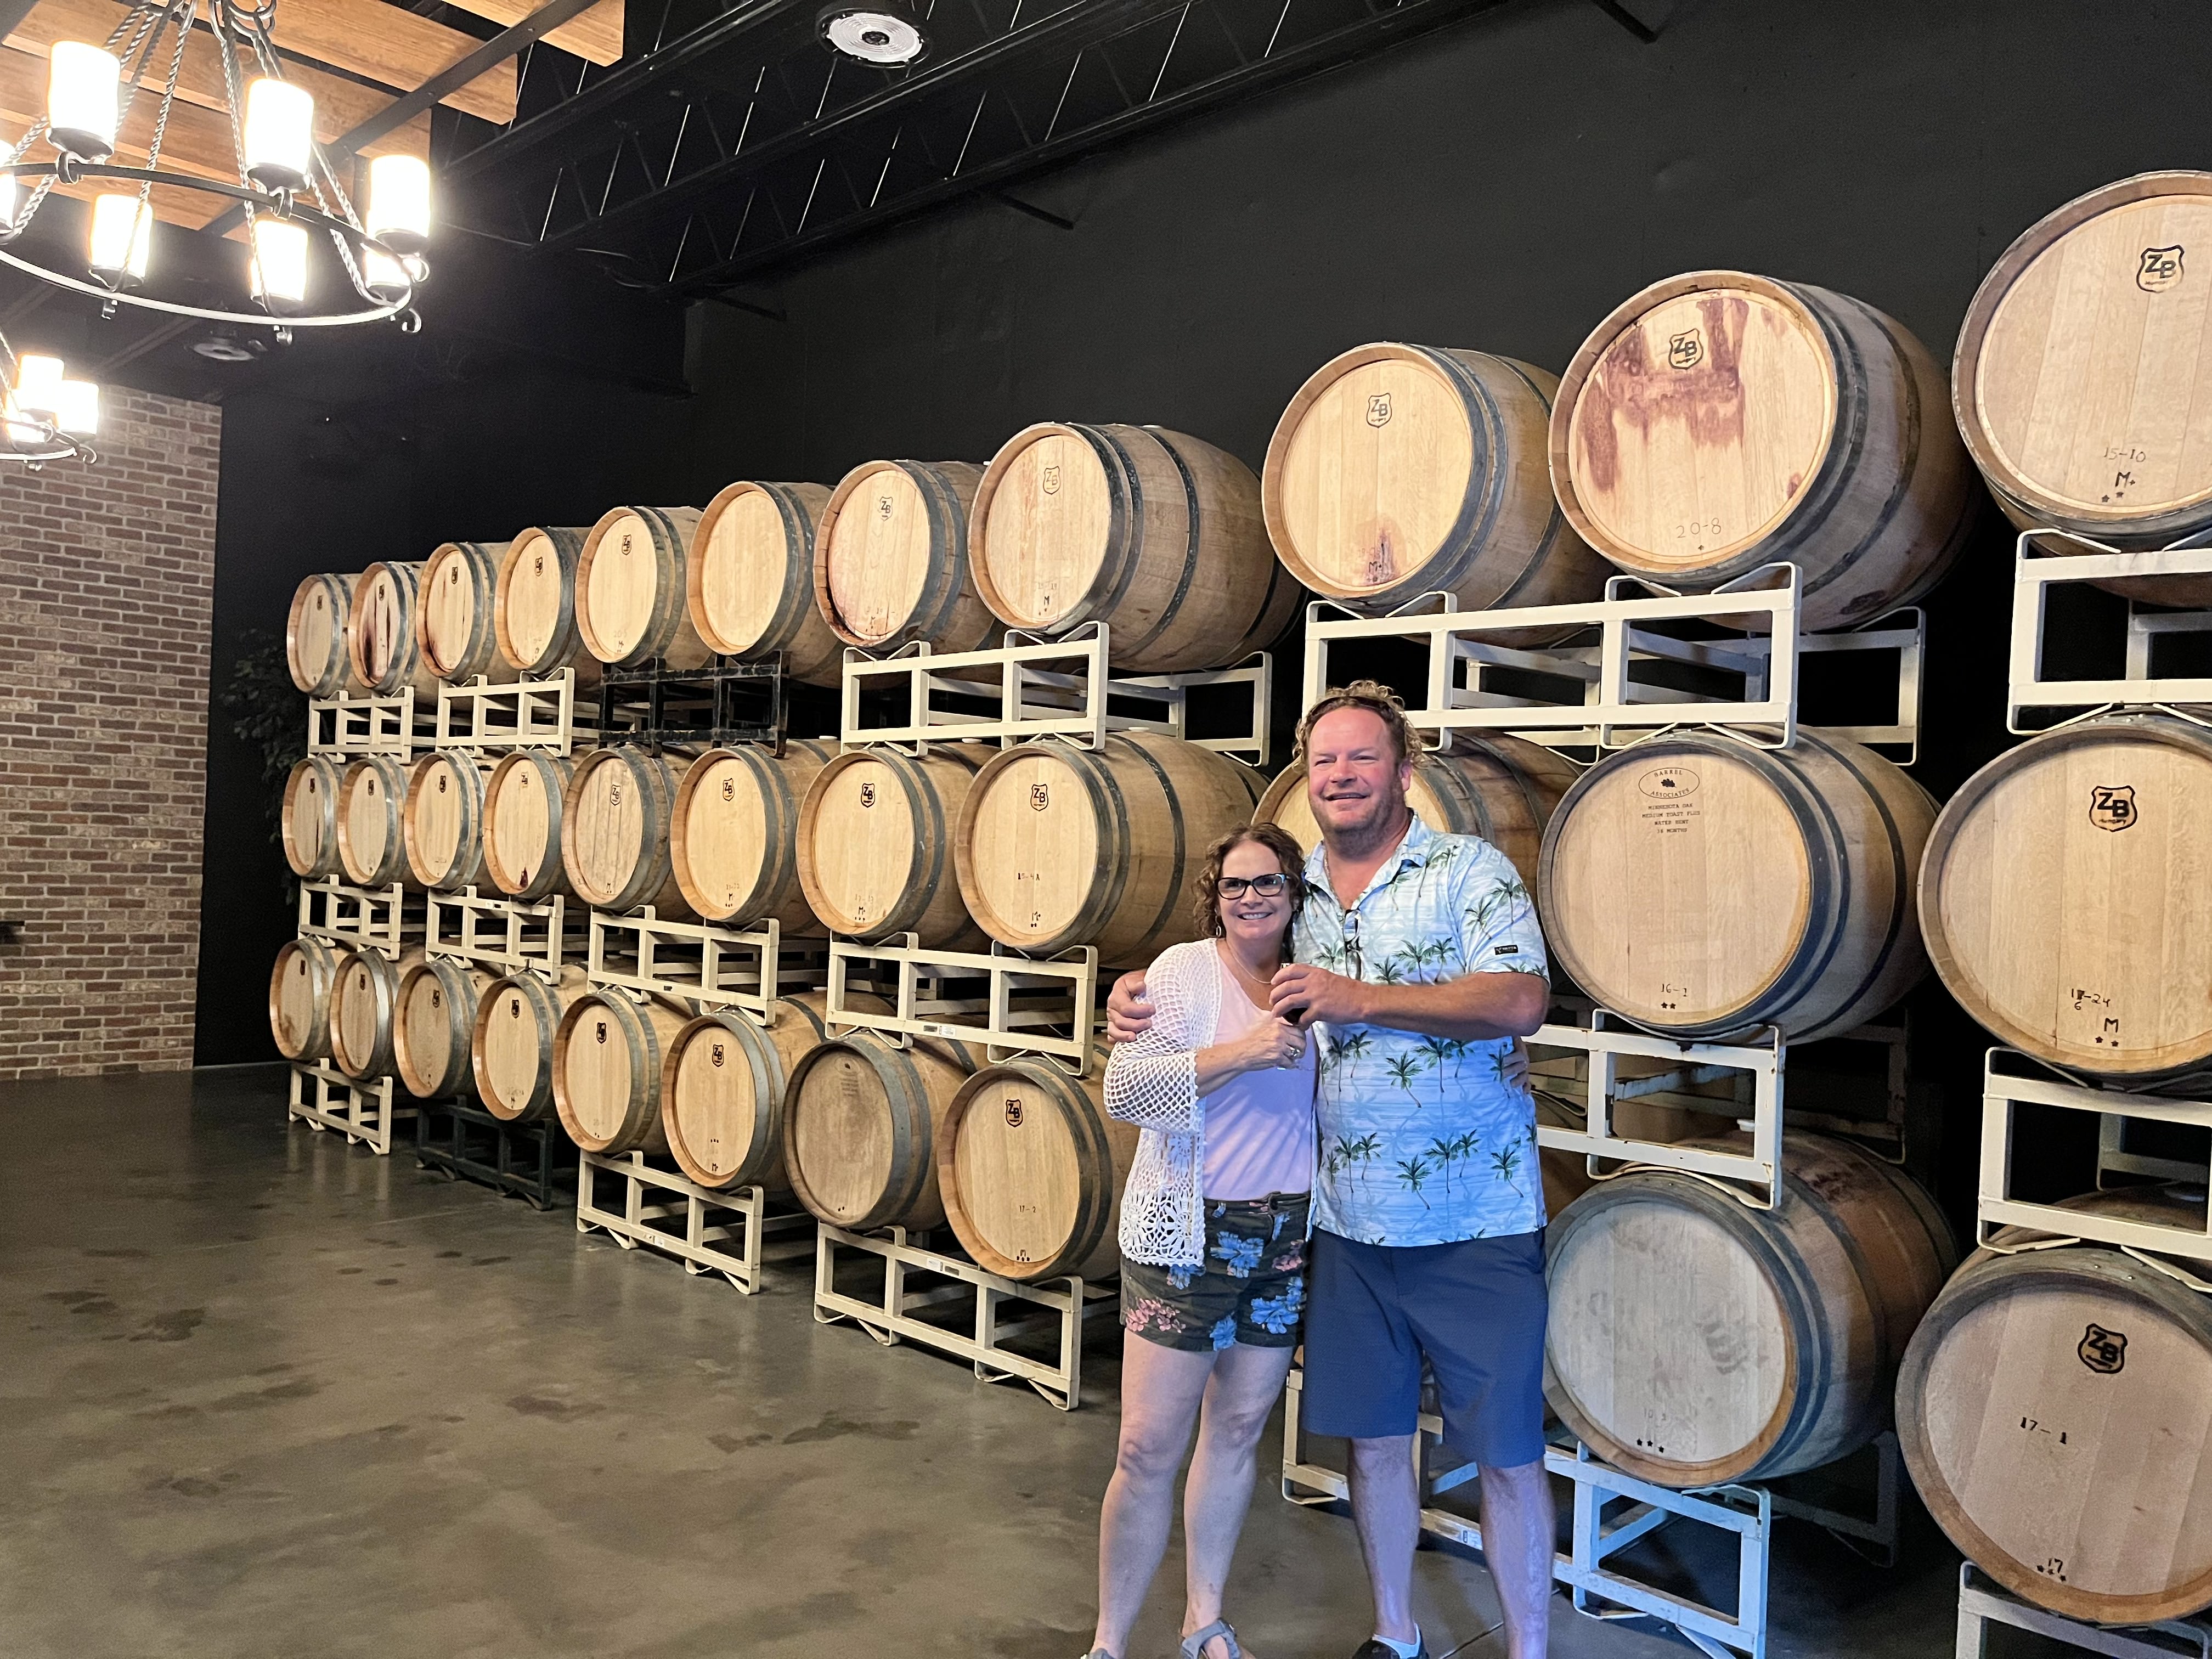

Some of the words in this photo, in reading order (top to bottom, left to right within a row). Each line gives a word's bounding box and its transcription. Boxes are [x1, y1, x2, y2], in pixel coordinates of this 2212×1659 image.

[2145, 253, 2176, 279] ZB
[1674, 337, 1697, 358] ZB
[1370, 399, 1388, 417] ZB
[1046, 471, 1058, 486] ZB
[881, 500, 891, 514] ZB
[1654, 769, 1683, 778] BARREL
[724, 782, 733, 794] ZB
[863, 786, 873, 800] ZB
[1034, 788, 1046, 803] ZB
[1650, 787, 1690, 798] ASSOCIATES
[2097, 792, 2129, 818] ZB
[2104, 1017, 2119, 1033] M
[713, 1047, 723, 1060] ZB
[1007, 1103, 1020, 1119] ZB
[2087, 1330, 2119, 1364] ZB
